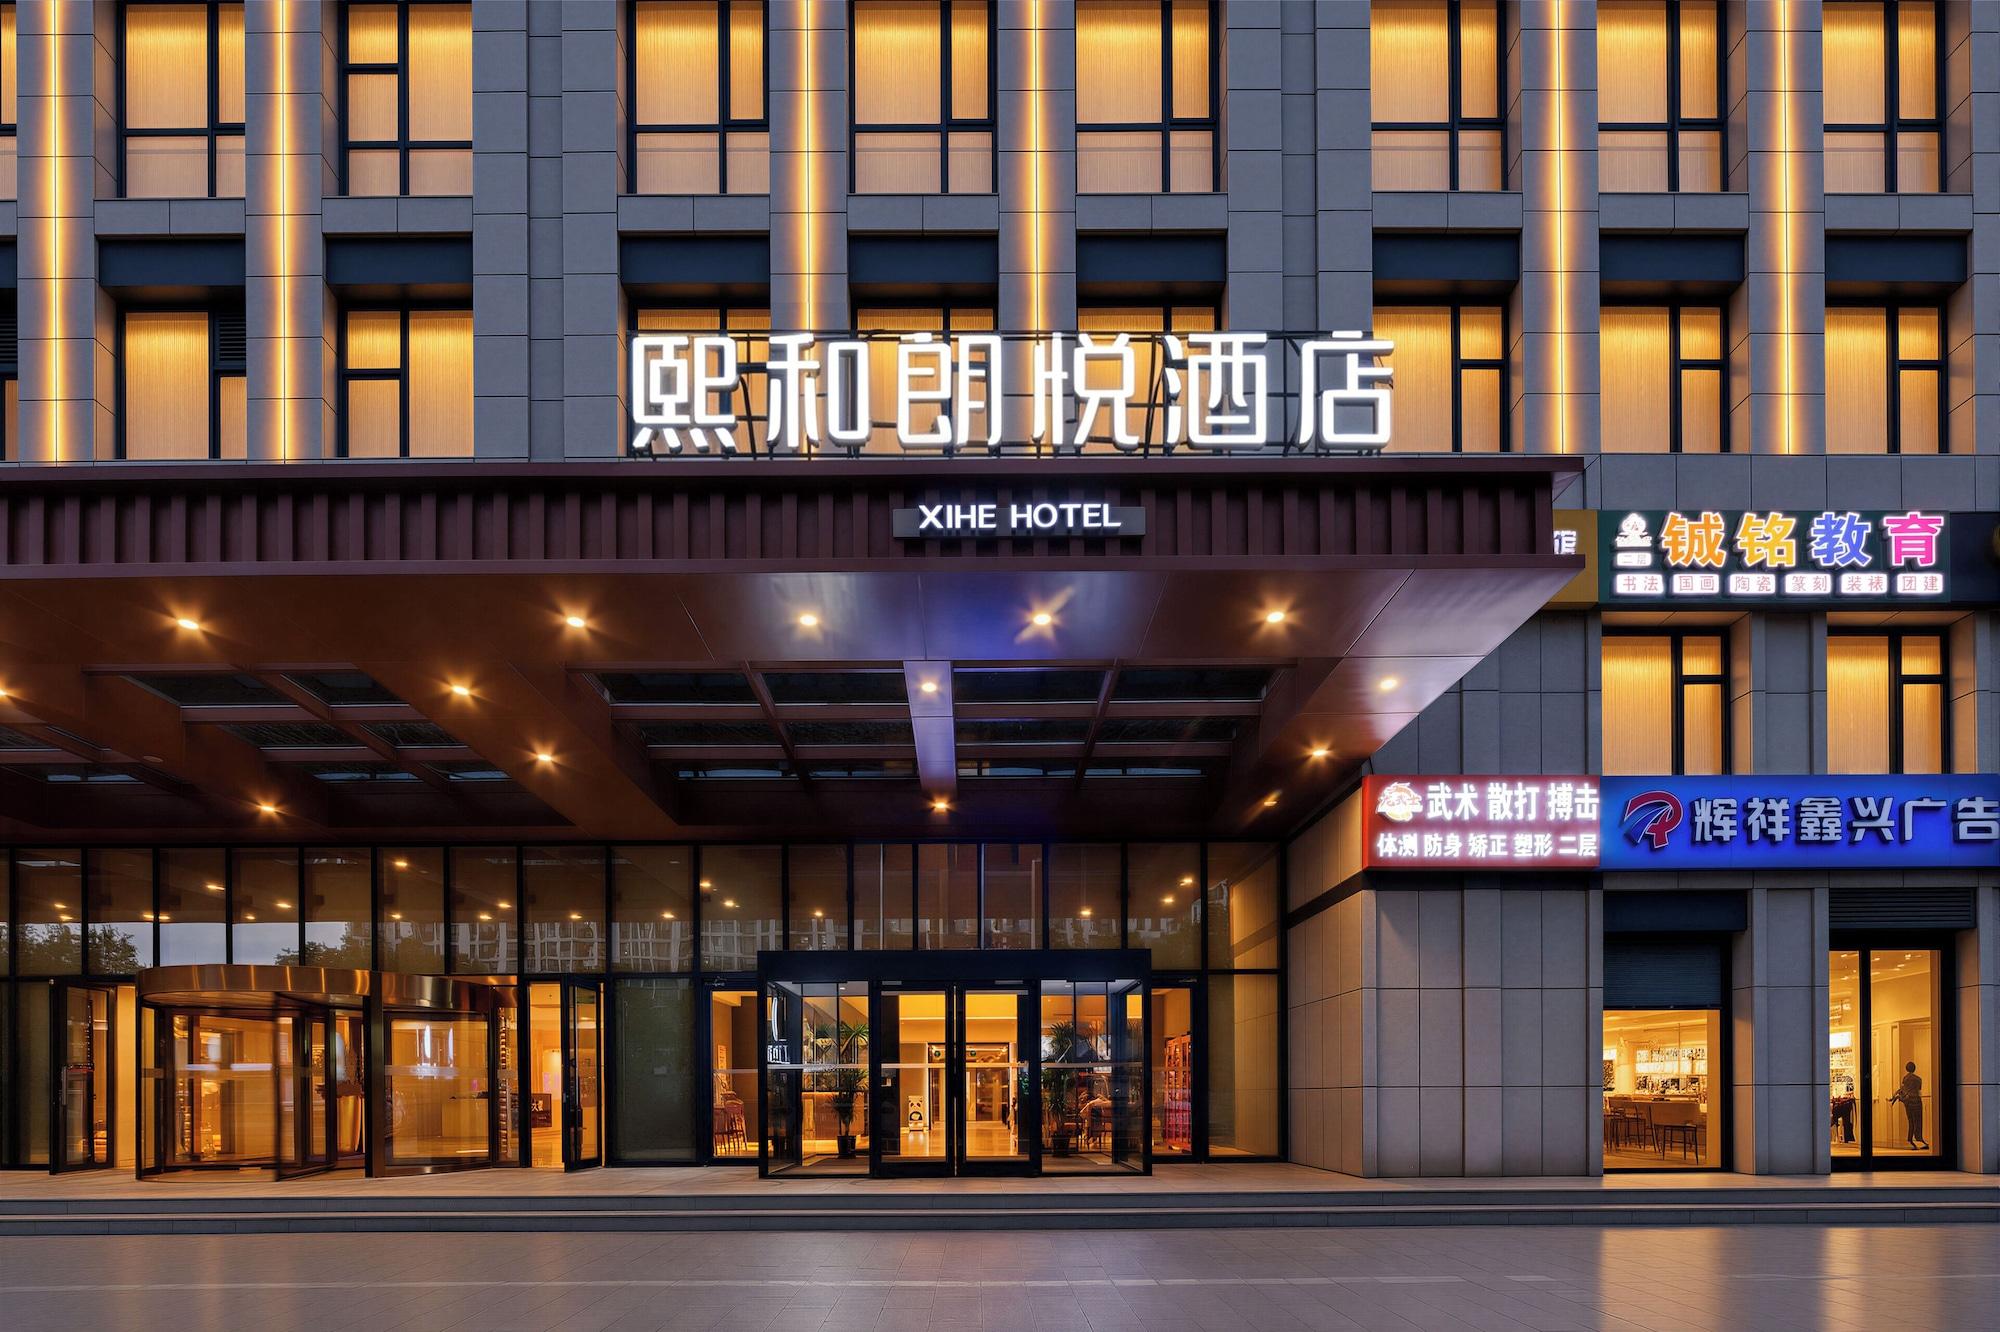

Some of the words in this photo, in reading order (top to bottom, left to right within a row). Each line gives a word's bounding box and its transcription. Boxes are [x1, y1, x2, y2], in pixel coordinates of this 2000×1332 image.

[632, 331, 1394, 449] 熙和朗悦酒店
[918, 504, 997, 529] XIHE
[1010, 503, 1122, 529] HOTEL
[1661, 512, 1944, 568] 铖铭教育
[1622, 576, 1659, 592] 书法
[1678, 575, 1715, 592] 国画
[1734, 575, 1772, 592] 陶瓷
[1791, 575, 1828, 592] 篆刻
[1847, 575, 1884, 592] 装裱
[1902, 575, 1939, 592] 团建
[1426, 782, 1480, 820] 武术
[1487, 782, 1540, 821] 散打
[1547, 782, 1600, 821] 搏击
[1693, 796, 2000, 843] 辉祥鑫兴广告
[1377, 833, 1418, 857] 体测
[1423, 833, 1463, 857] 防身
[1468, 833, 1508, 857] 矫正
[1513, 833, 1553, 858] 塑形
[1558, 833, 1598, 857] 二层
